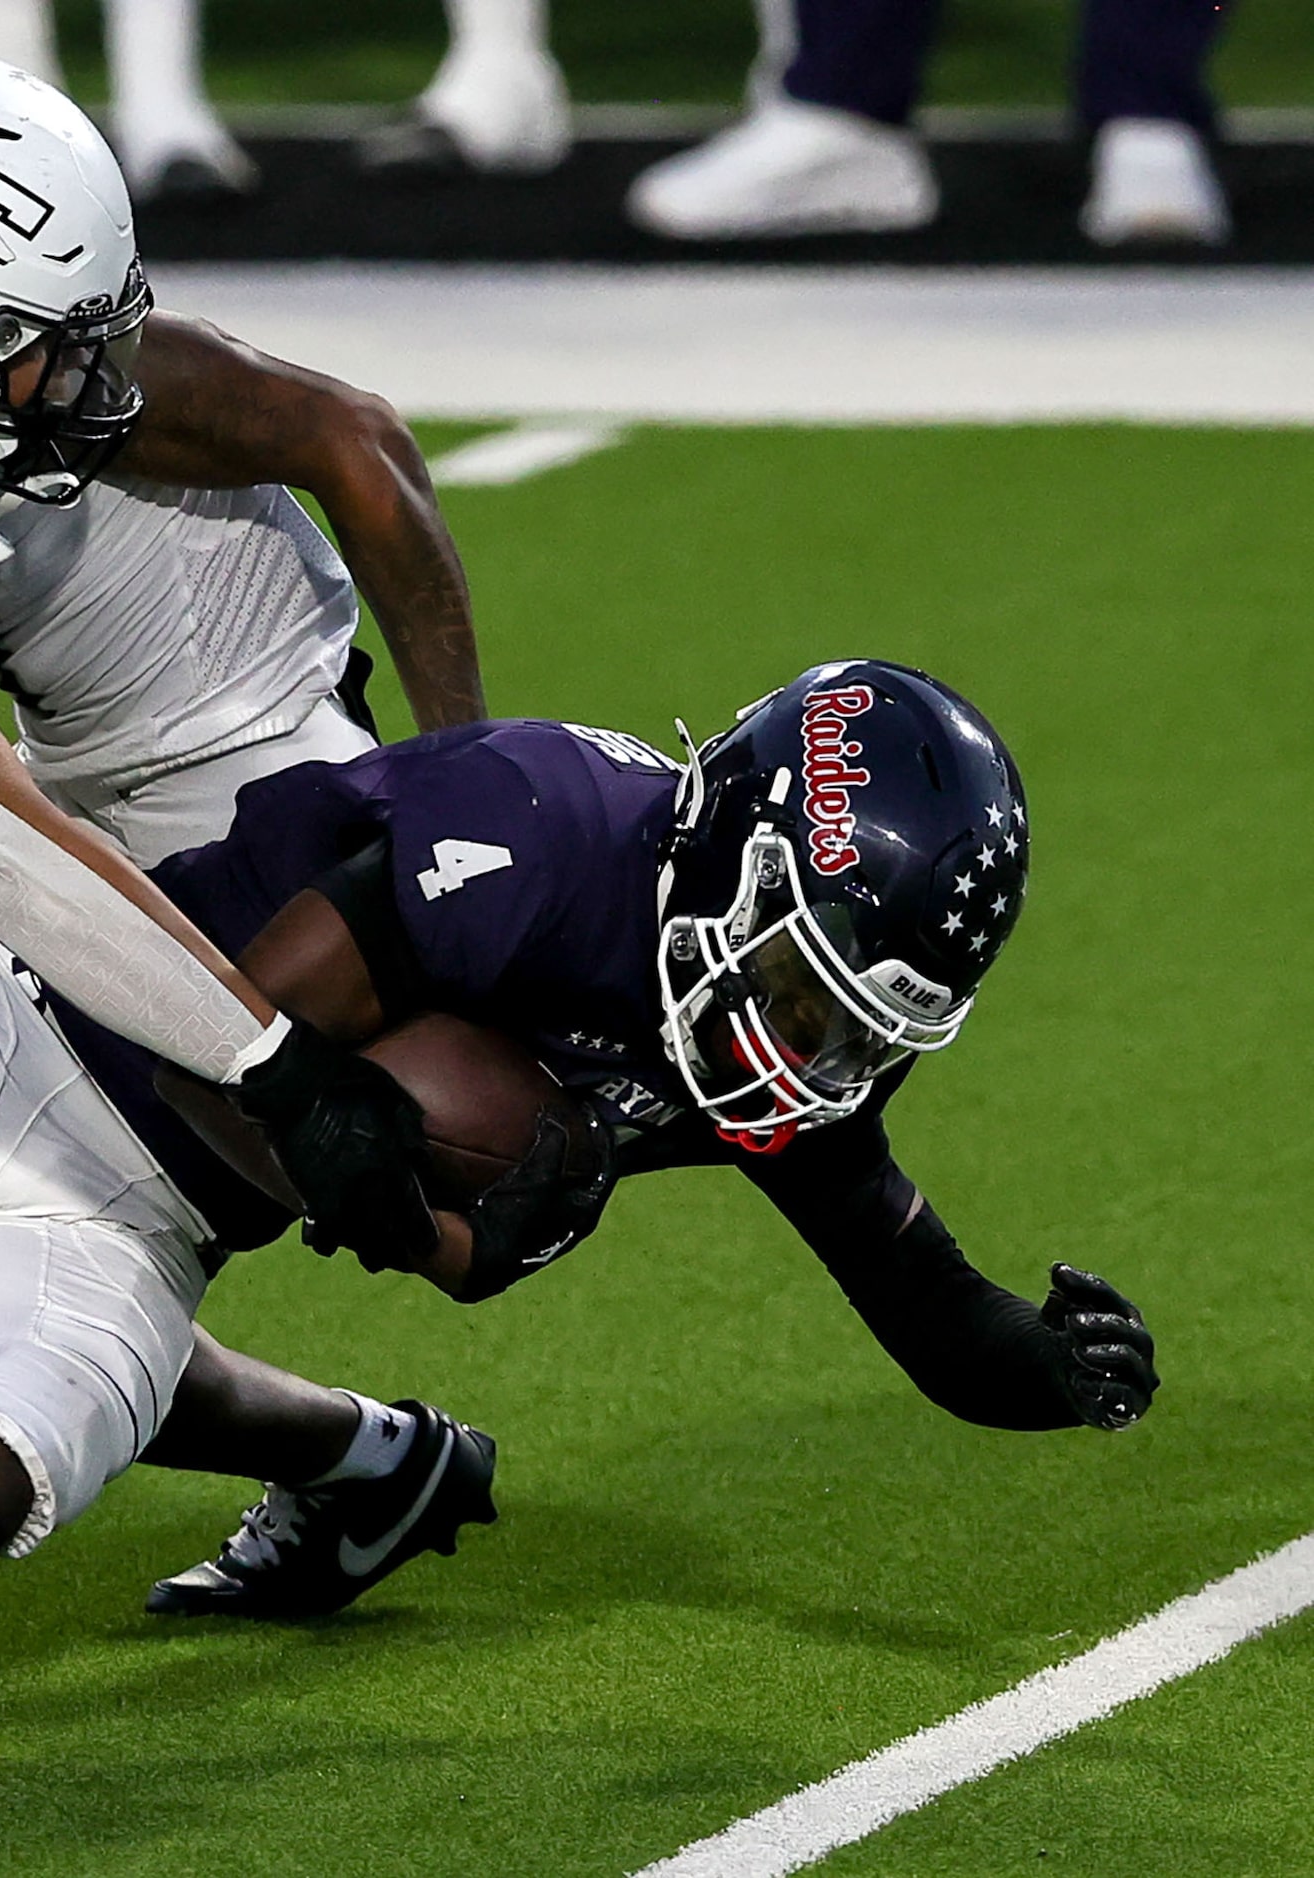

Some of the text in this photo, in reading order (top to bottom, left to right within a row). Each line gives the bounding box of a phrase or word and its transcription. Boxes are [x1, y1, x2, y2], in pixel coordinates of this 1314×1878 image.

[801, 686, 874, 876] Raiders
[416, 839, 514, 901] 4
[889, 975, 941, 1009] BLUE
